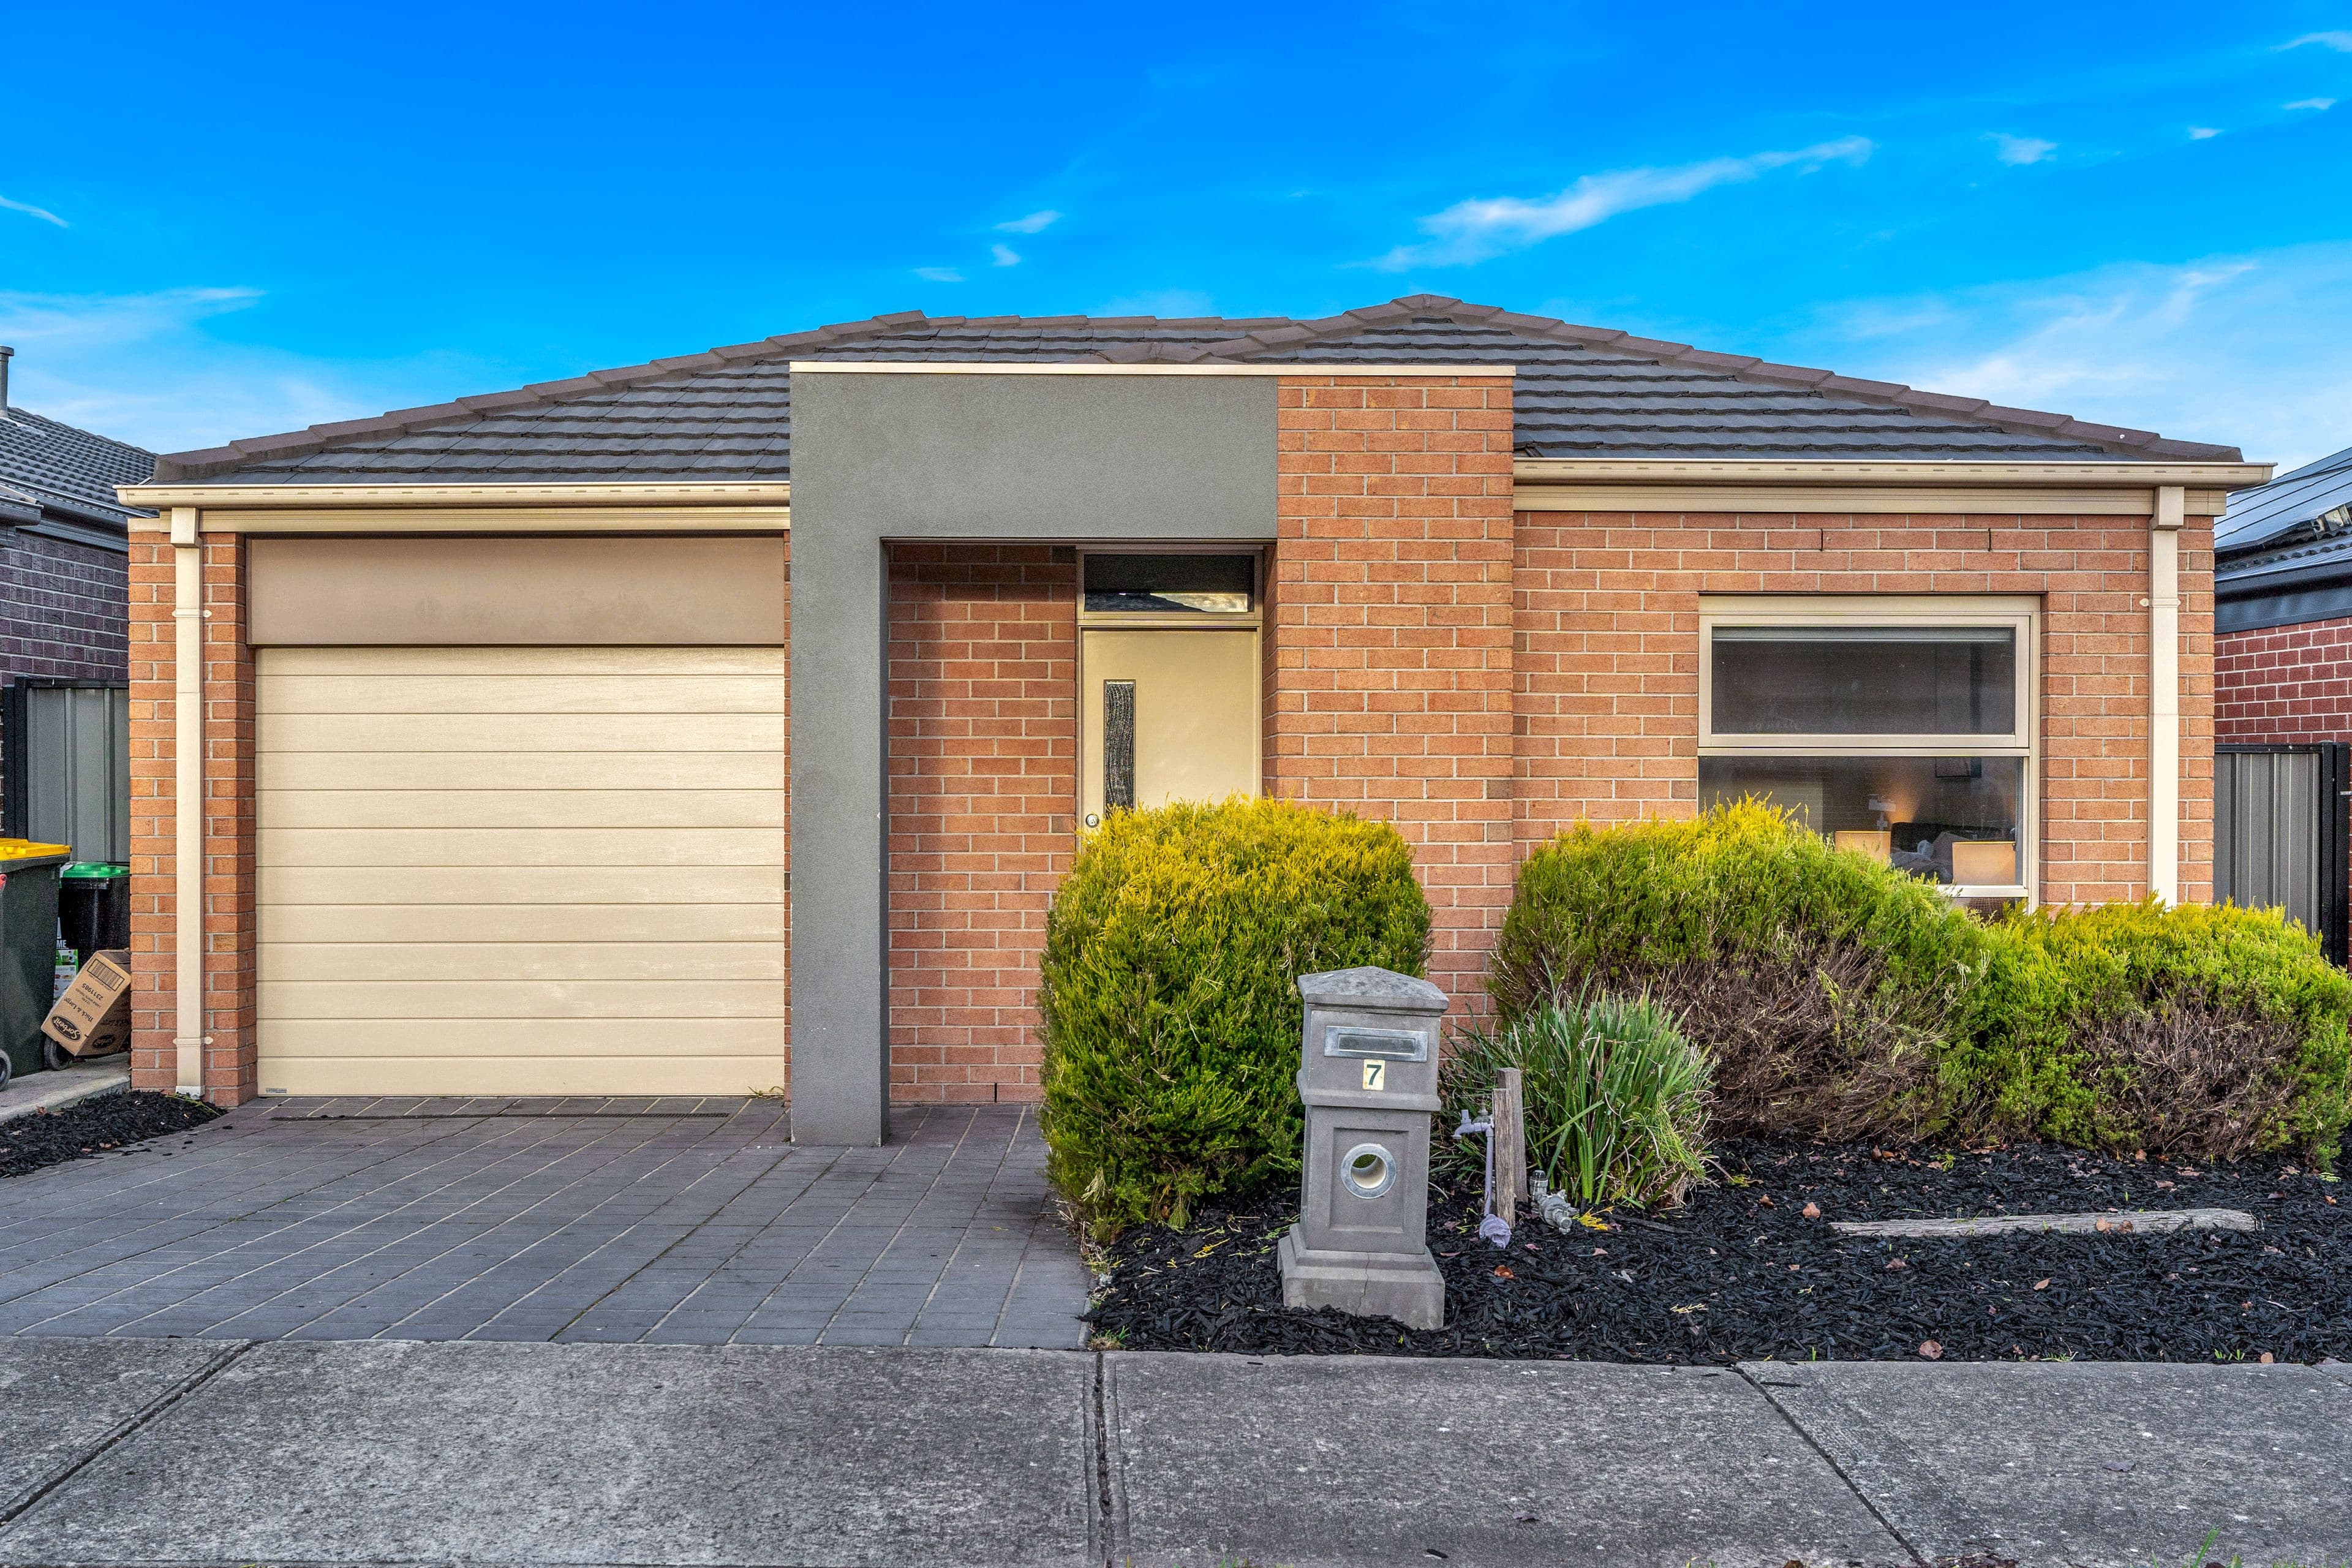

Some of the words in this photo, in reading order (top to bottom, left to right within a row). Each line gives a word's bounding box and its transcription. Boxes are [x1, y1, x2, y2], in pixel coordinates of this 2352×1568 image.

[82, 983, 104, 1001] 2311985
[64, 997, 77, 1009] Large
[81, 1010, 94, 1022] Thick
[53, 1017, 80, 1039] Sorbent
[1366, 1064, 1382, 1085] 7
